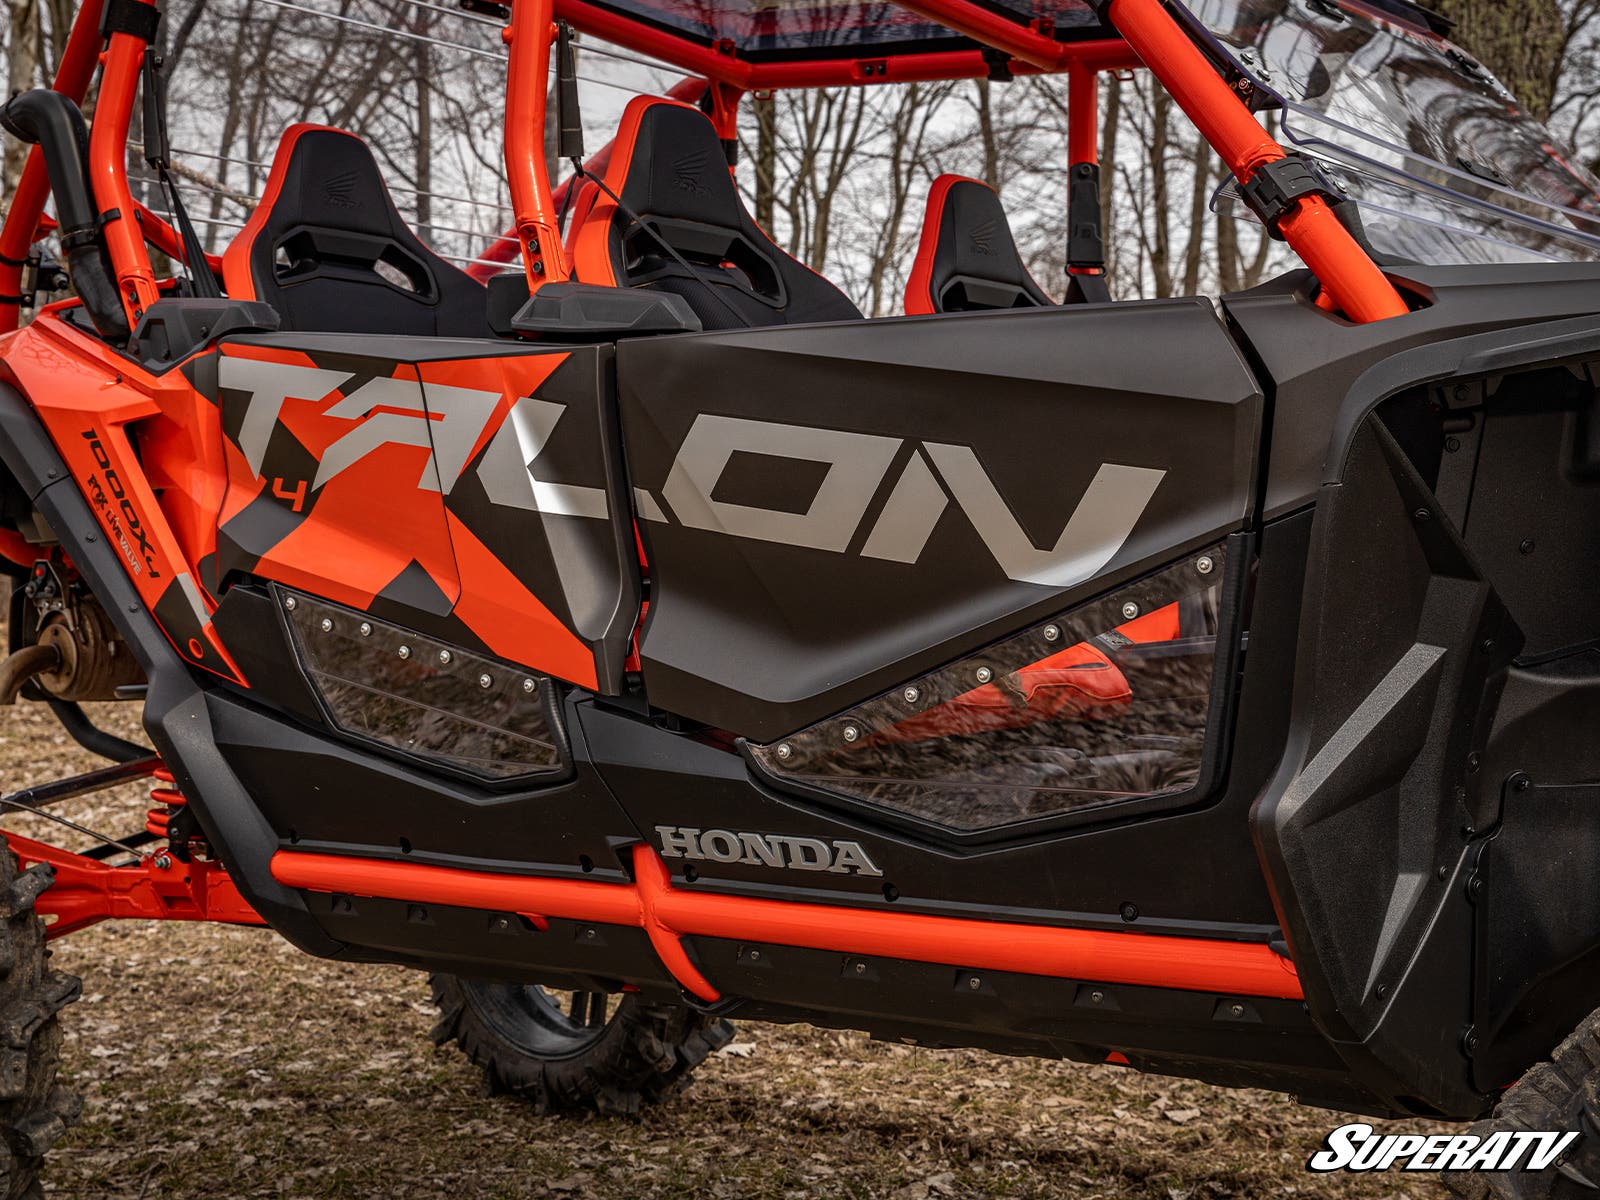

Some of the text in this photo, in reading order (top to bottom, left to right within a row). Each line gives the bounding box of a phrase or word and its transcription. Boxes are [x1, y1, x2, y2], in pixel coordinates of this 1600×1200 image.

[218, 355, 1167, 588] TALON
[272, 477, 308, 513] 4
[655, 825, 884, 877] HONDA
